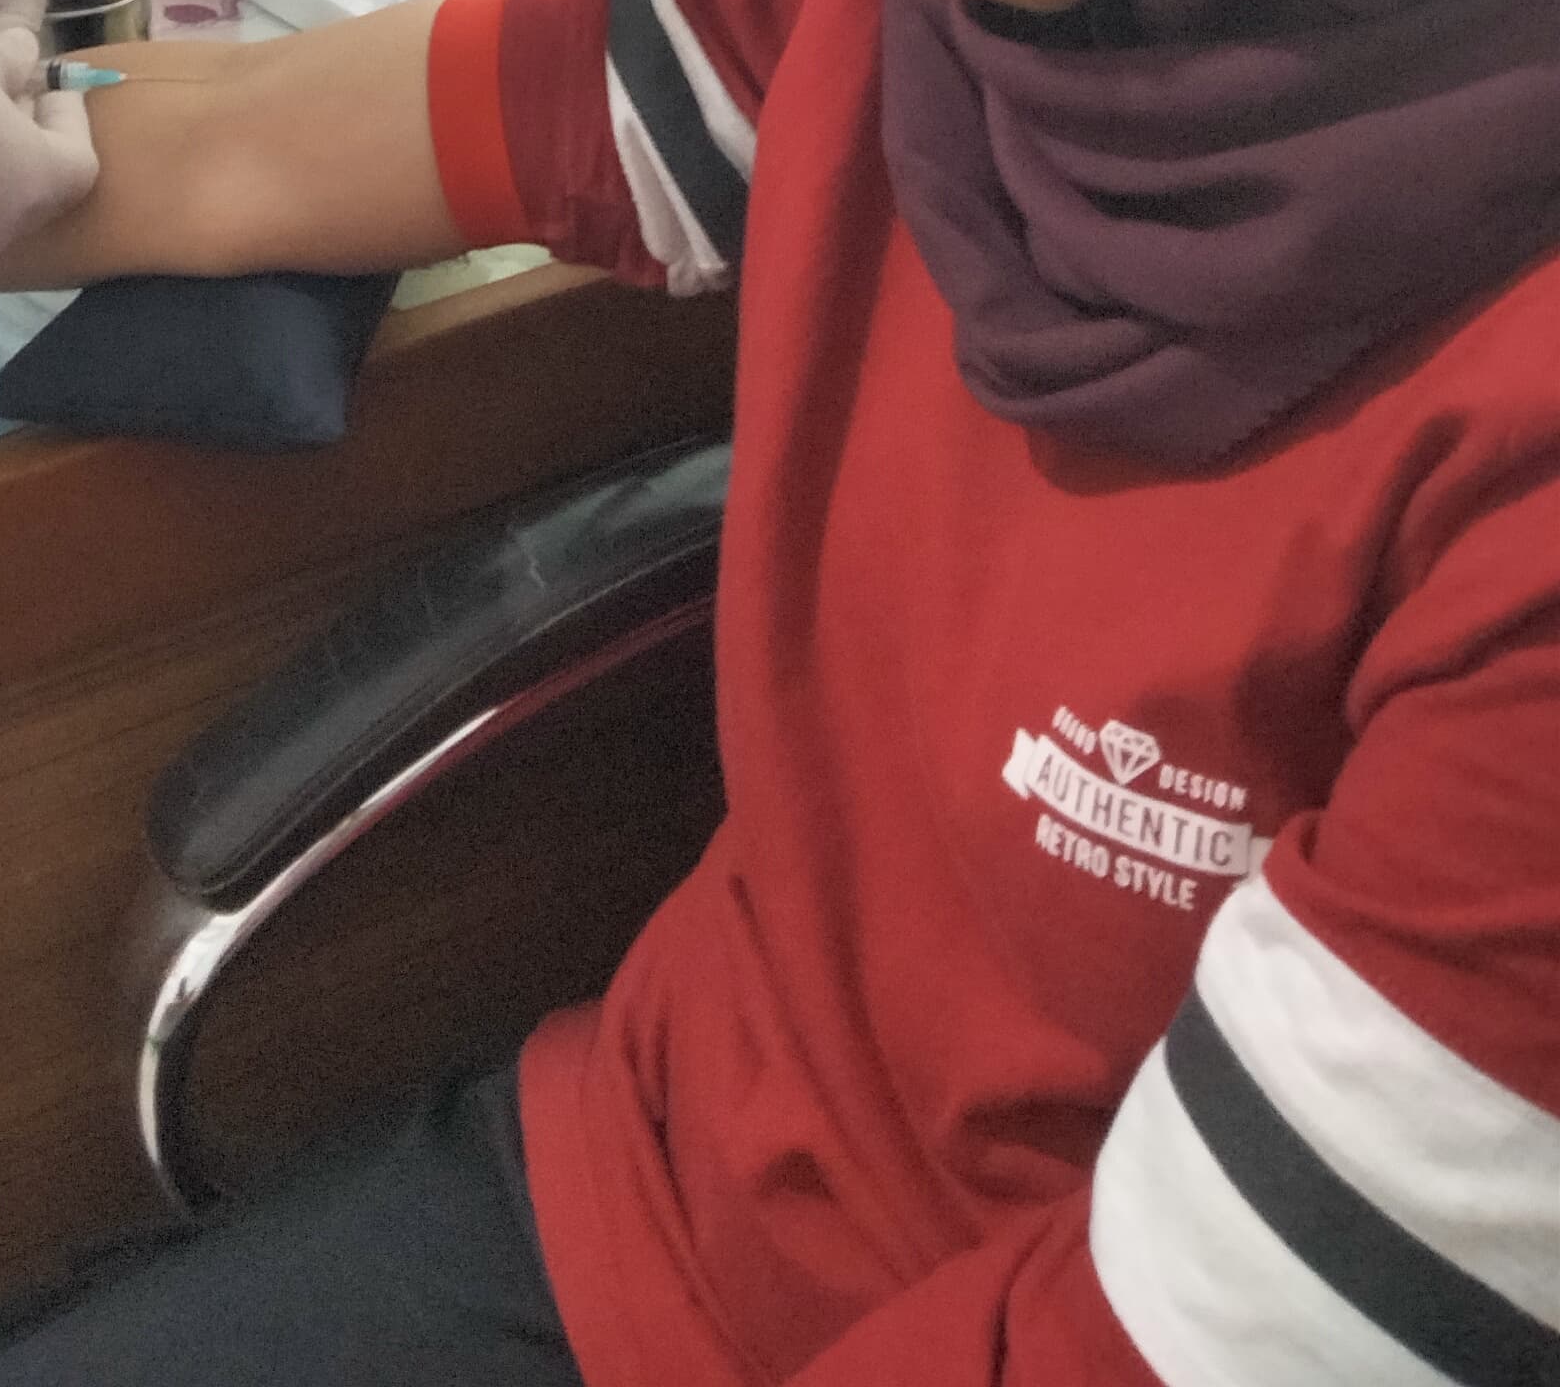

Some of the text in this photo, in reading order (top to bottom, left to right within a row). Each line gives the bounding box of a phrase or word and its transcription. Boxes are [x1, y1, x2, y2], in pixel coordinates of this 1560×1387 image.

[1035, 813, 1198, 911] RETRO STYLE
[1037, 753, 1235, 867] AUTHENTIC
